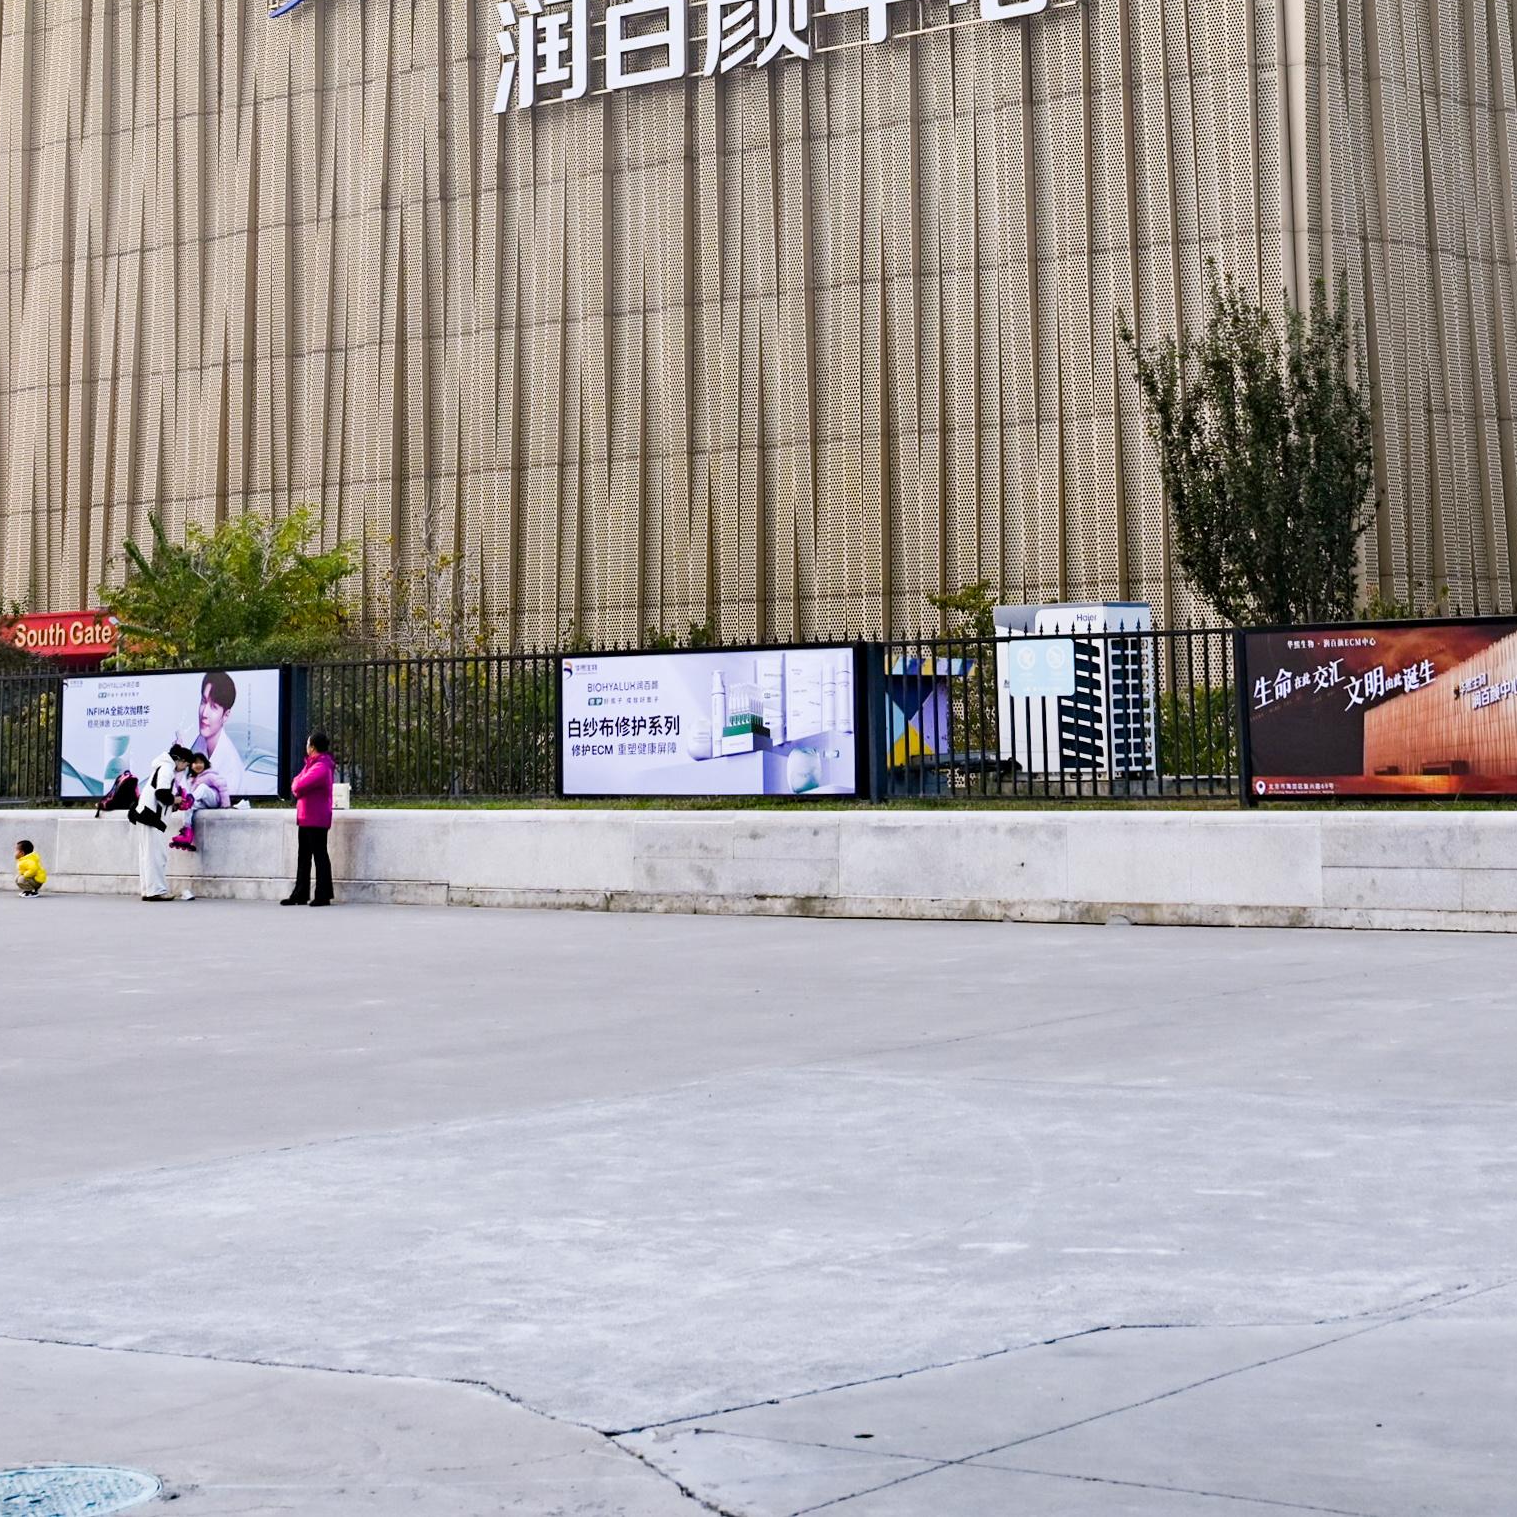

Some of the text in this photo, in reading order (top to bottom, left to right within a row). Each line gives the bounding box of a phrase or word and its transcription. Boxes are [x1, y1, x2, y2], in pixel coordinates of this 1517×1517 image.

[1076, 613, 1097, 622] Haier
[14, 622, 65, 648] South
[70, 621, 112, 645] Gate
[1253, 658, 1346, 710] 生命在此交汇
[1343, 659, 1437, 712] 文明由此诞生
[568, 715, 681, 739] 白纱布修护系列
